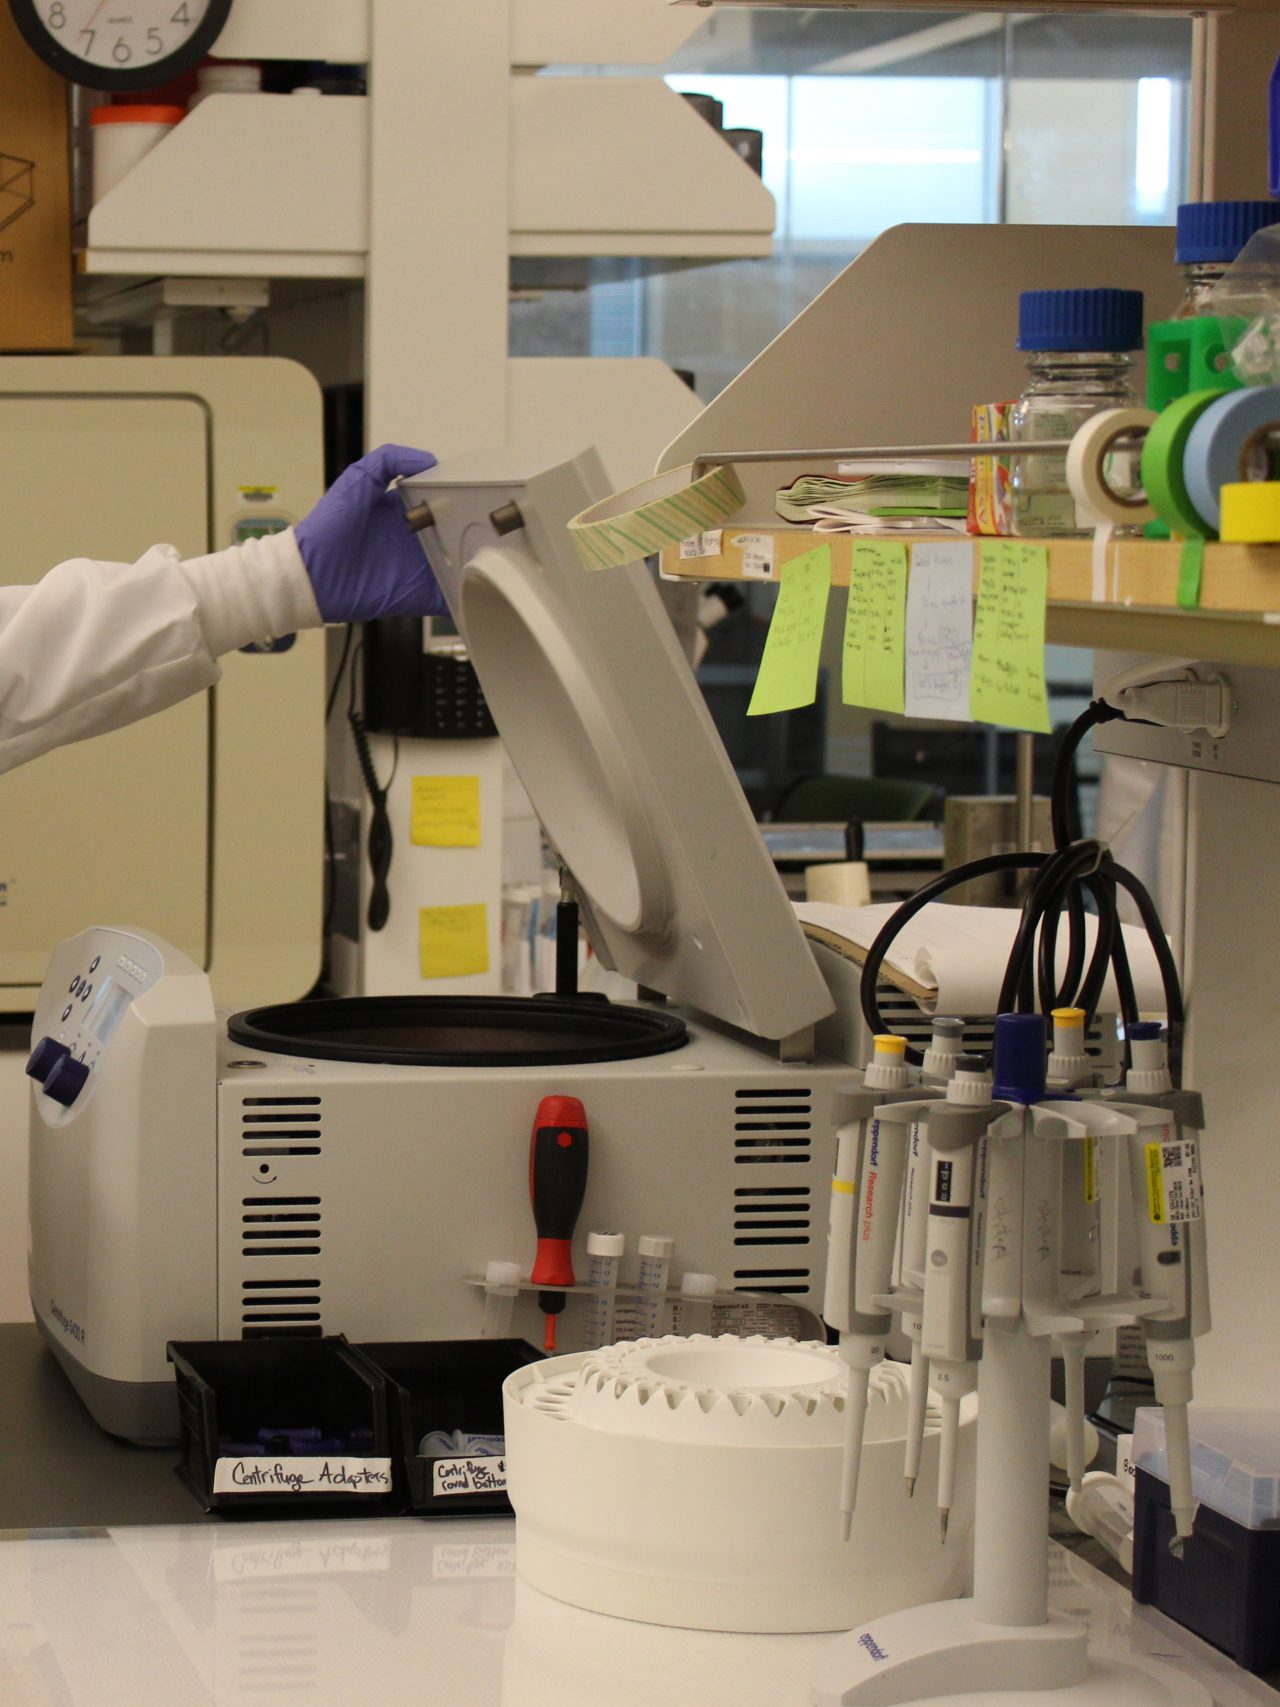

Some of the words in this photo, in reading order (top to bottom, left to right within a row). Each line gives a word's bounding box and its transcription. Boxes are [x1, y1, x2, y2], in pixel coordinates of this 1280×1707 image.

[48, 1, 66, 29] 8
[171, 2, 190, 26] 4
[79, 29, 96, 56] 7
[112, 36, 131, 63] 6
[145, 27, 163, 55] 5
[865, 1171, 877, 1219] Research
[1155, 1353, 1174, 1361] 1000
[232, 1462, 314, 1491] Centrifuge
[319, 1462, 389, 1489] Adapters
[857, 1633, 889, 1661] eppendorf
